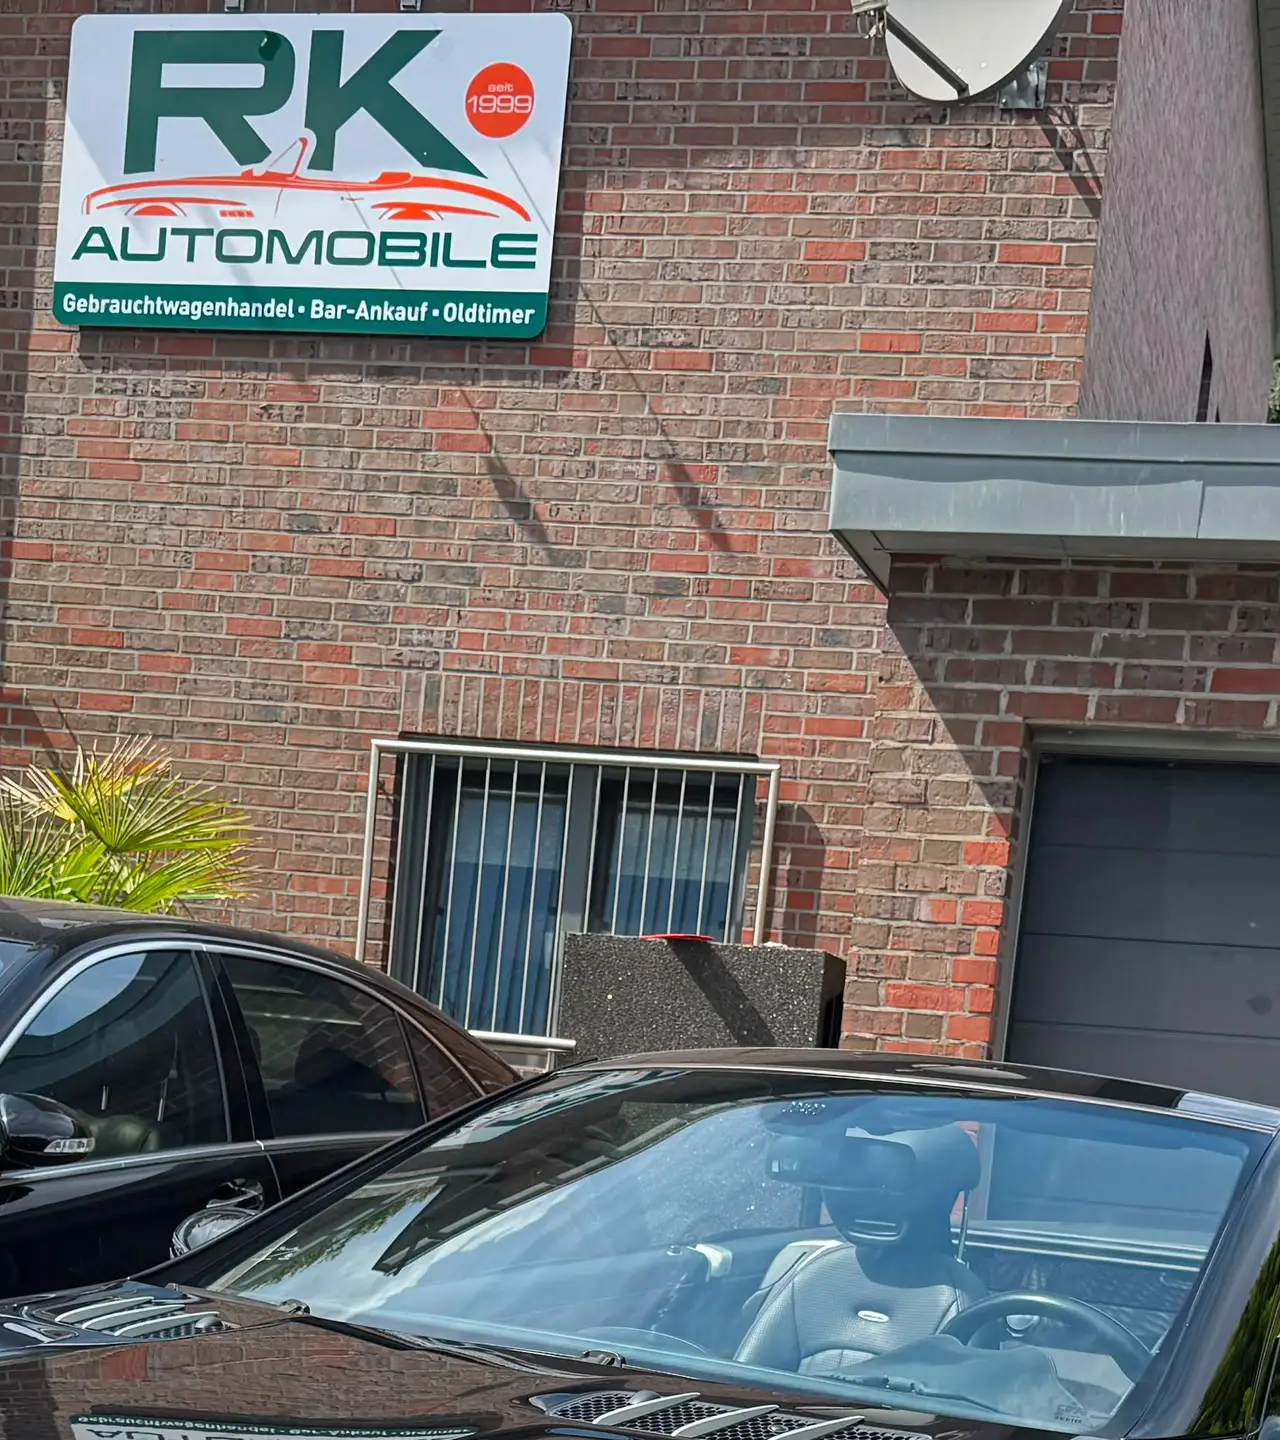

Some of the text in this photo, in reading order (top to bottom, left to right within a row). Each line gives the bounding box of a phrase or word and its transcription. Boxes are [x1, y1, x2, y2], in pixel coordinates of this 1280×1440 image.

[487, 82, 514, 92] seit
[123, 29, 488, 179] RK
[467, 94, 532, 113] 1999
[71, 226, 538, 269] AUTOMOBILE
[62, 293, 536, 325] Gebrauchtwagenhandel Bar-Ankauf Oldtimer
